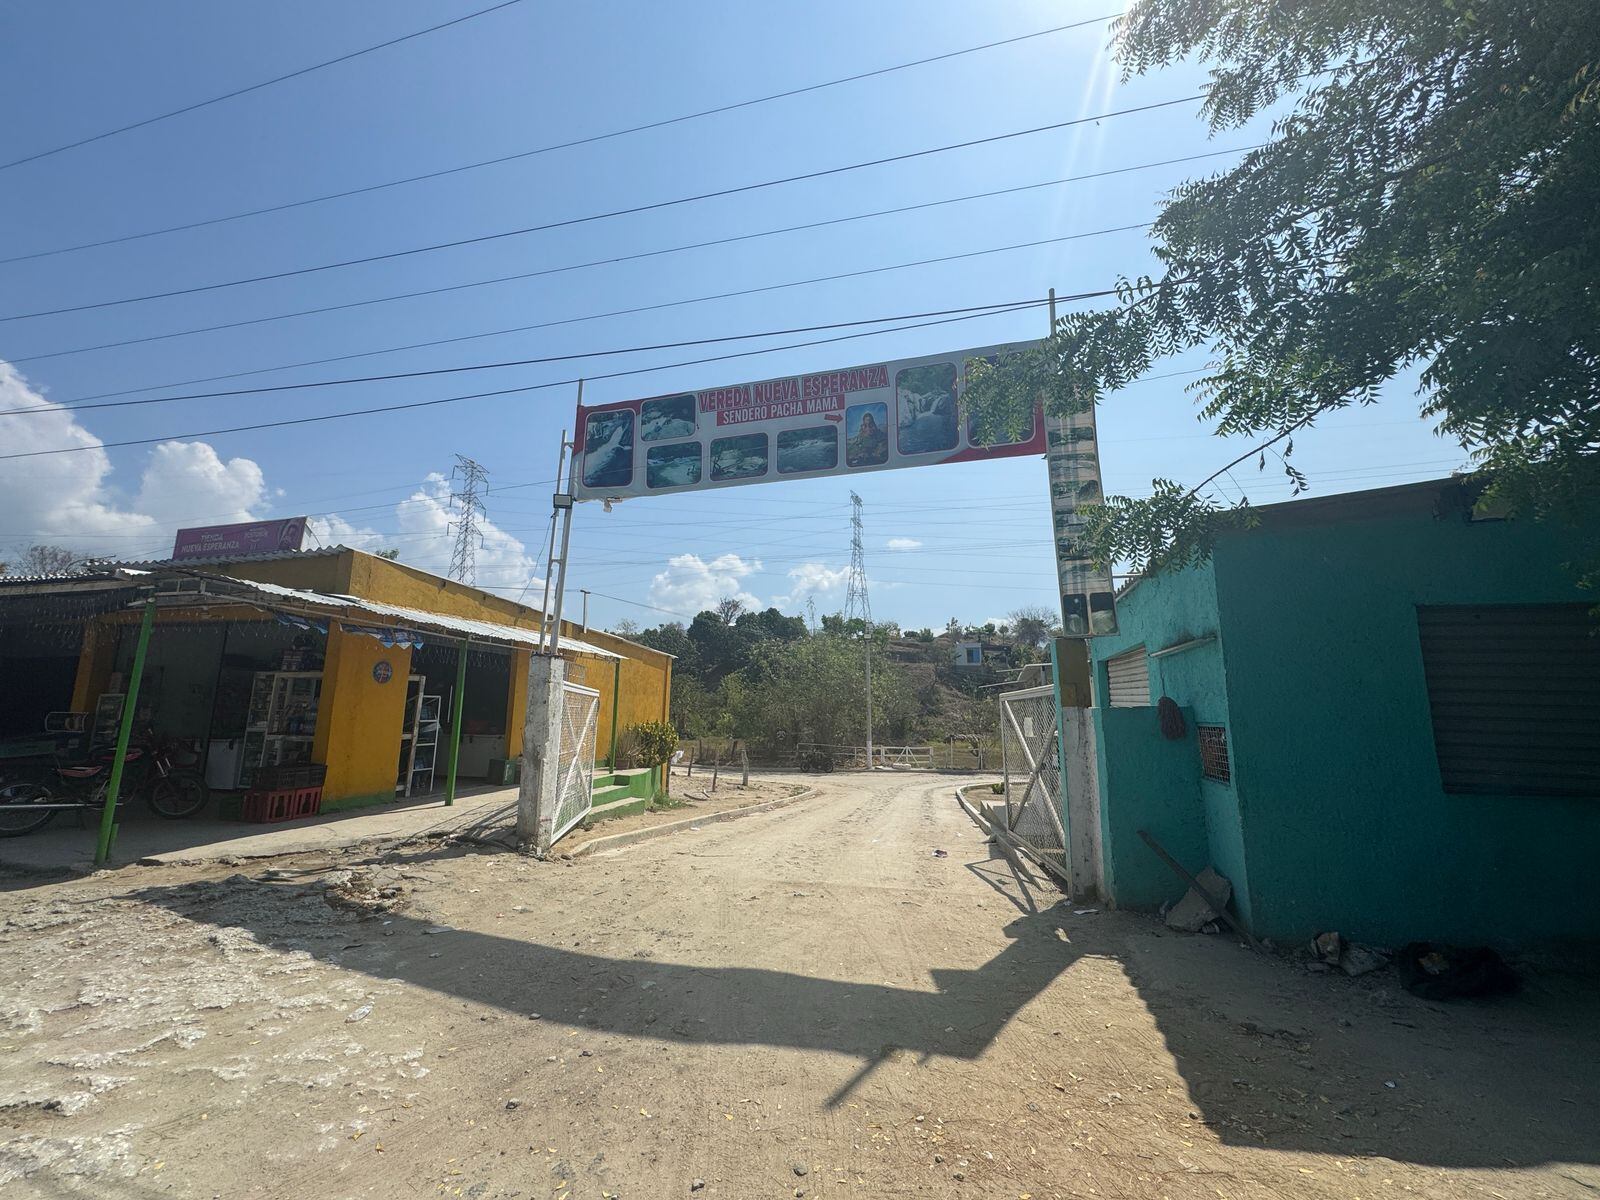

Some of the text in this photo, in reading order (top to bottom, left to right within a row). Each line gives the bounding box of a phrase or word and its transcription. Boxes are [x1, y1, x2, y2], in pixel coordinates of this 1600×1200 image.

[699, 366, 889, 412] VEREDA NUEVA ESPERANZA
[723, 397, 839, 424] SENDERO PACHA MAMA
[181, 541, 240, 553] NUEVA ESPERANZA
